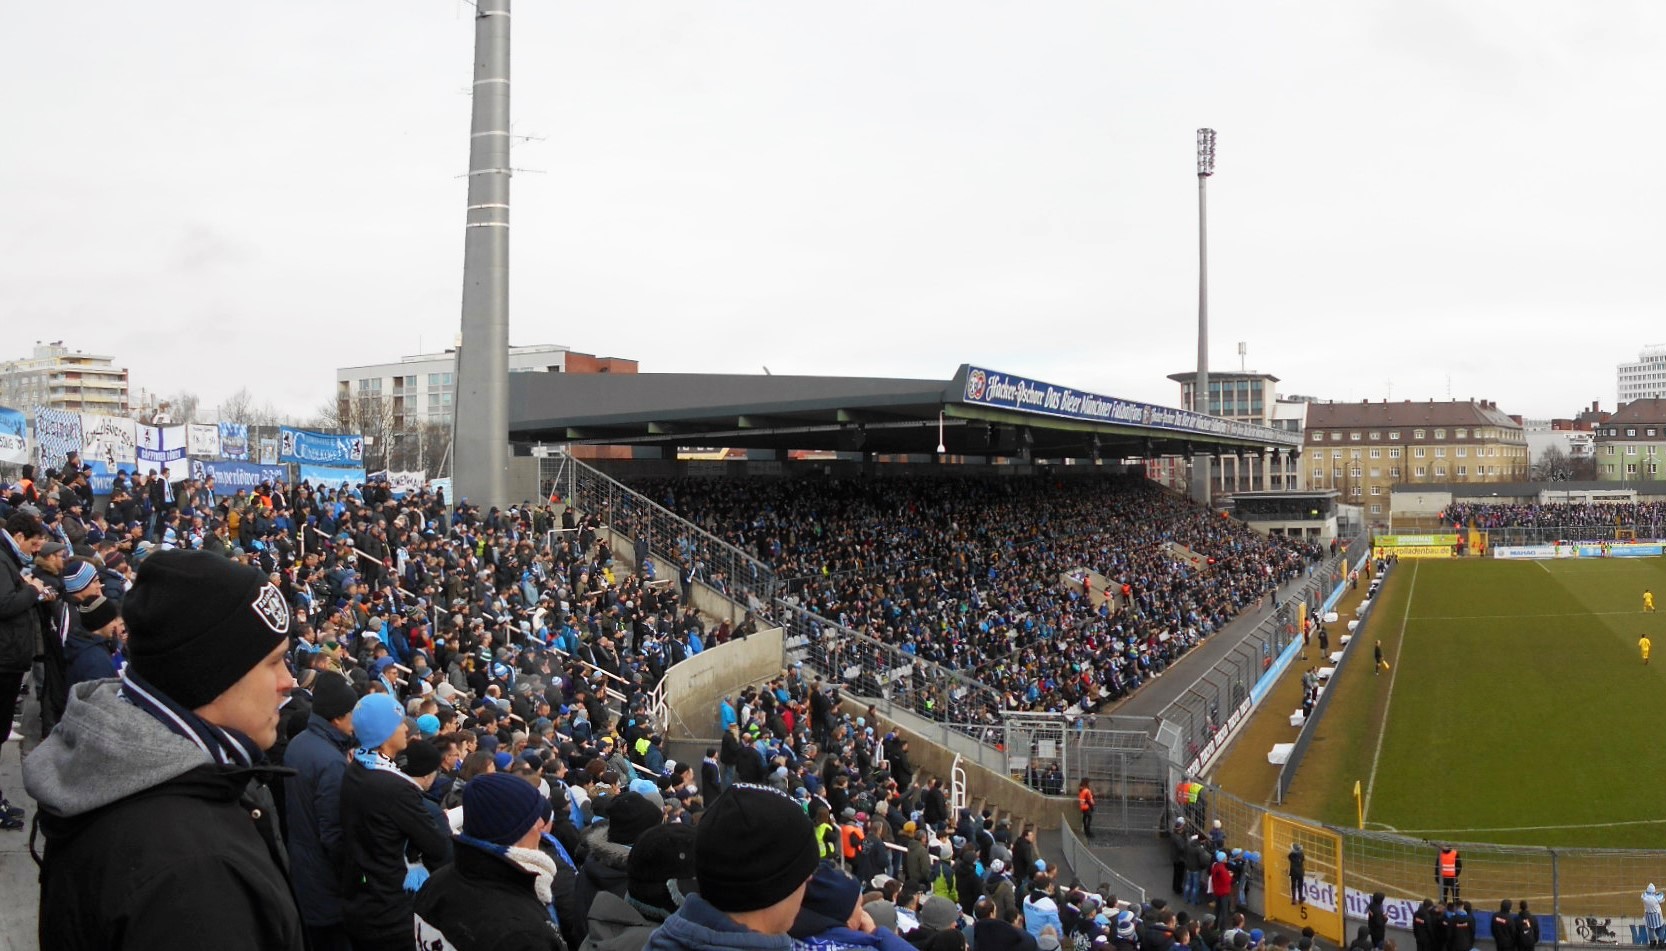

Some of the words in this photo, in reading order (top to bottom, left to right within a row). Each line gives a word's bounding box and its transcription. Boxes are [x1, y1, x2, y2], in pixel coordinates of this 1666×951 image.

[985, 375, 1044, 407] Hacker-Pschorr
[1044, 387, 1060, 408] Das
[1080, 395, 1113, 416] Münchner
[207, 465, 260, 486] Amperlöwen
[1301, 906, 1308, 920] 5
